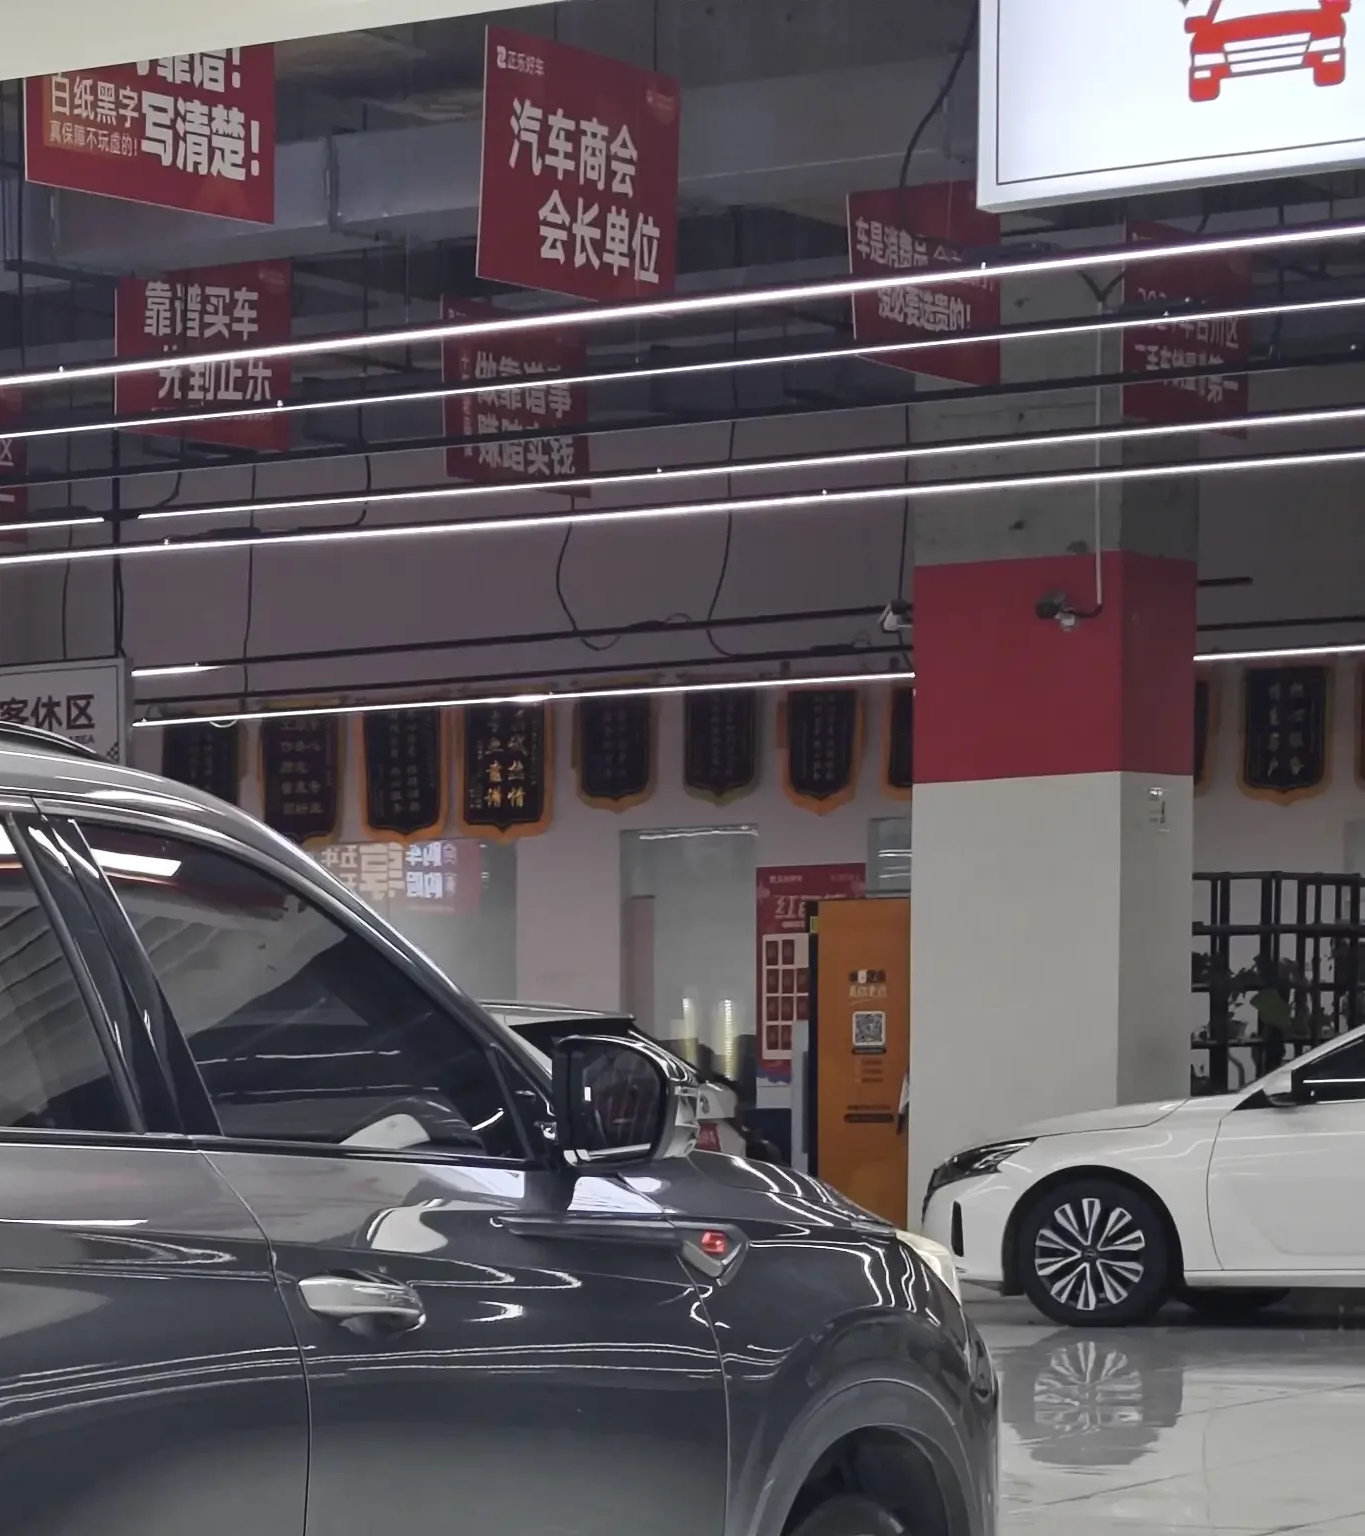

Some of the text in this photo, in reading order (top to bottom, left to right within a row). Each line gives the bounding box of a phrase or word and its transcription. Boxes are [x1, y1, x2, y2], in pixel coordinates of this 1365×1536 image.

[51, 72, 139, 128] 白纸黑字
[141, 90, 260, 181] 写清楚!
[49, 120, 138, 157] 真保障不玩虚的!
[509, 97, 638, 198] 汽车商会
[538, 188, 660, 284] 会长单位
[144, 281, 259, 341] 靠谱买车
